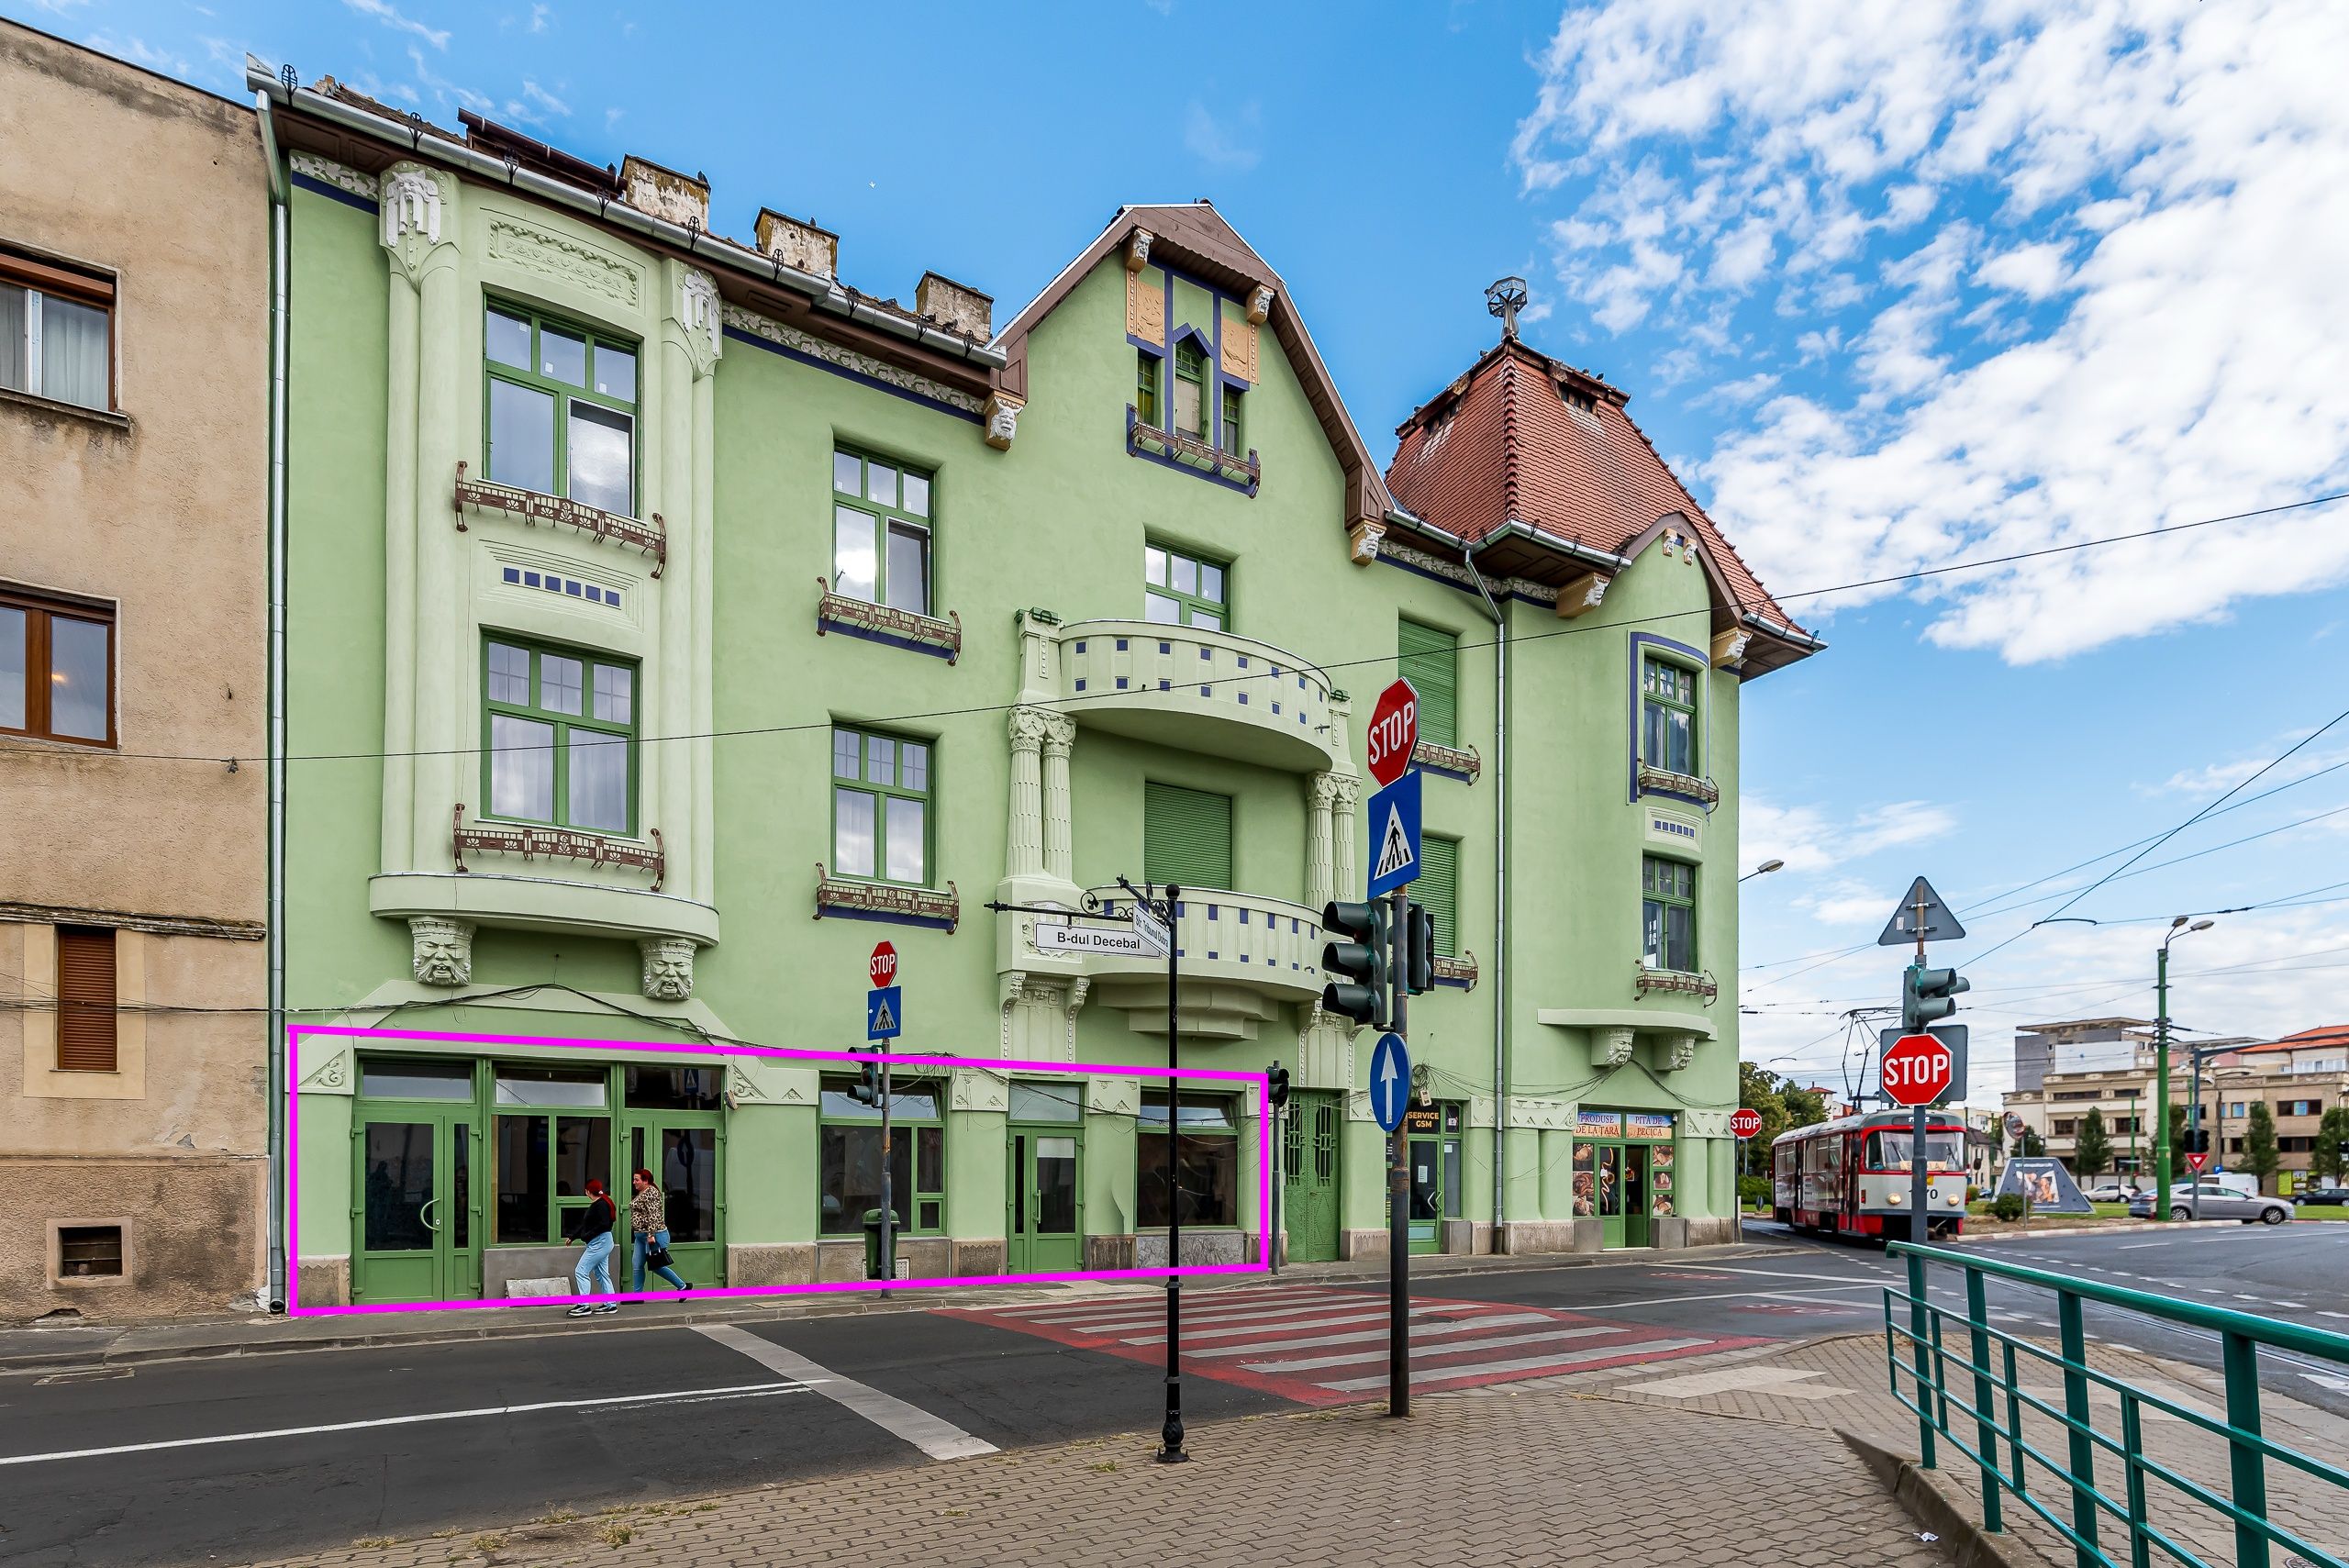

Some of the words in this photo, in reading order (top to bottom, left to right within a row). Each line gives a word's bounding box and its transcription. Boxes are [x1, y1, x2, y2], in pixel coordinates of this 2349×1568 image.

[1369, 701, 1415, 765] STOP
[1057, 931, 1089, 945] B-dul
[1093, 935, 1141, 950] Decebal
[871, 953, 896, 975] STOP
[1884, 1053, 1948, 1086] STOP
[1408, 1111, 1440, 1119] SERVICE
[1580, 1113, 1615, 1124] PRODUSE
[1416, 1119, 1432, 1128] GSM
[1653, 1117, 1663, 1125] DE
[1731, 1117, 1760, 1129] STOP
[1575, 1125, 1586, 1134] DE
[1587, 1126, 1598, 1134] LA
[1636, 1127, 1663, 1137] PECICA
